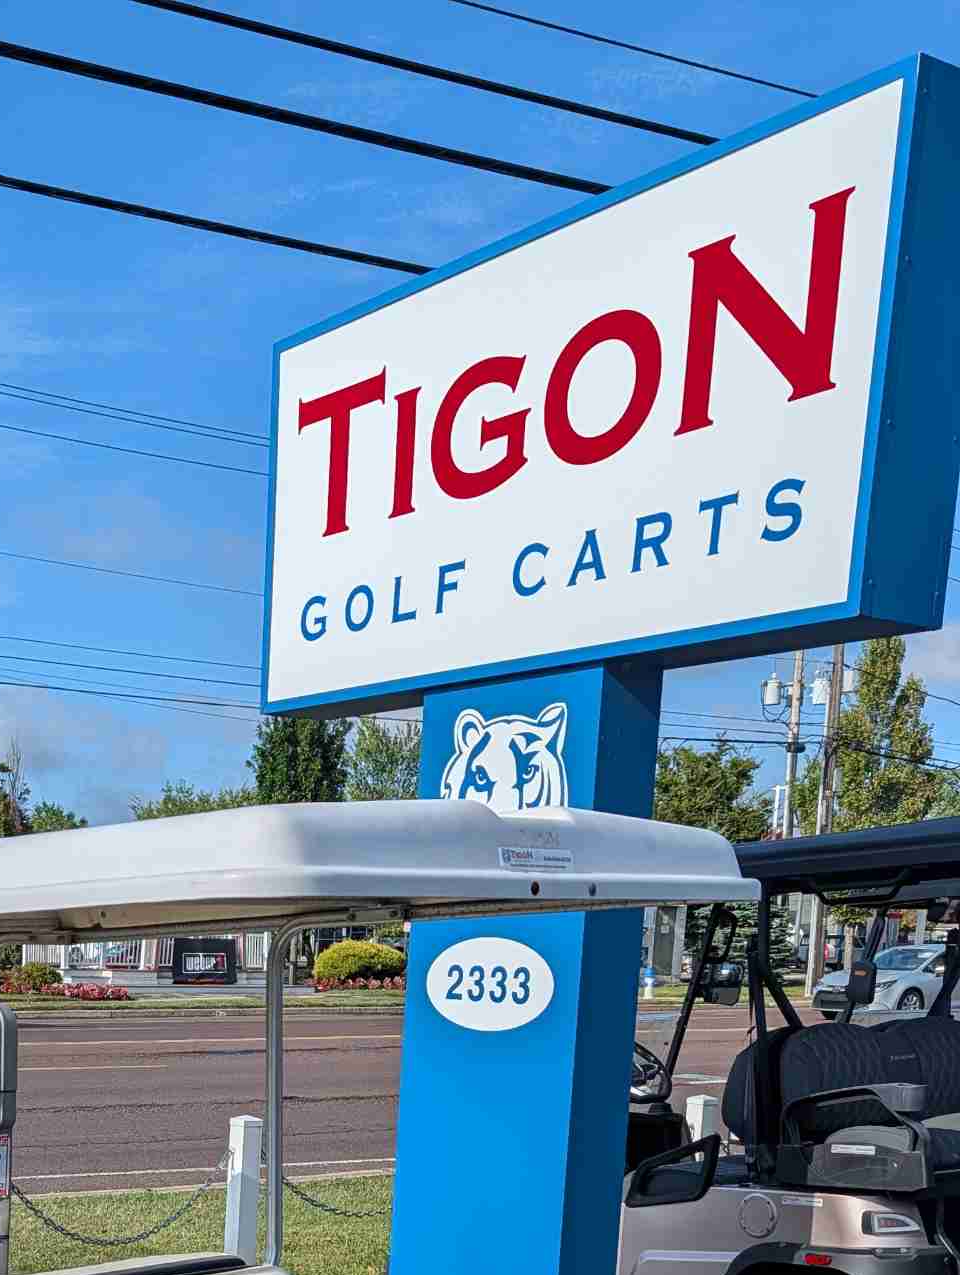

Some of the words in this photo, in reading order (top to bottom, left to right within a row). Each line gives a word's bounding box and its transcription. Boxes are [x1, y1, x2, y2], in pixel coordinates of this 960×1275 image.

[298, 186, 856, 537] TIGON
[300, 559, 466, 642] GOLF
[512, 478, 806, 597] CARTS
[446, 964, 530, 1005] 2333
